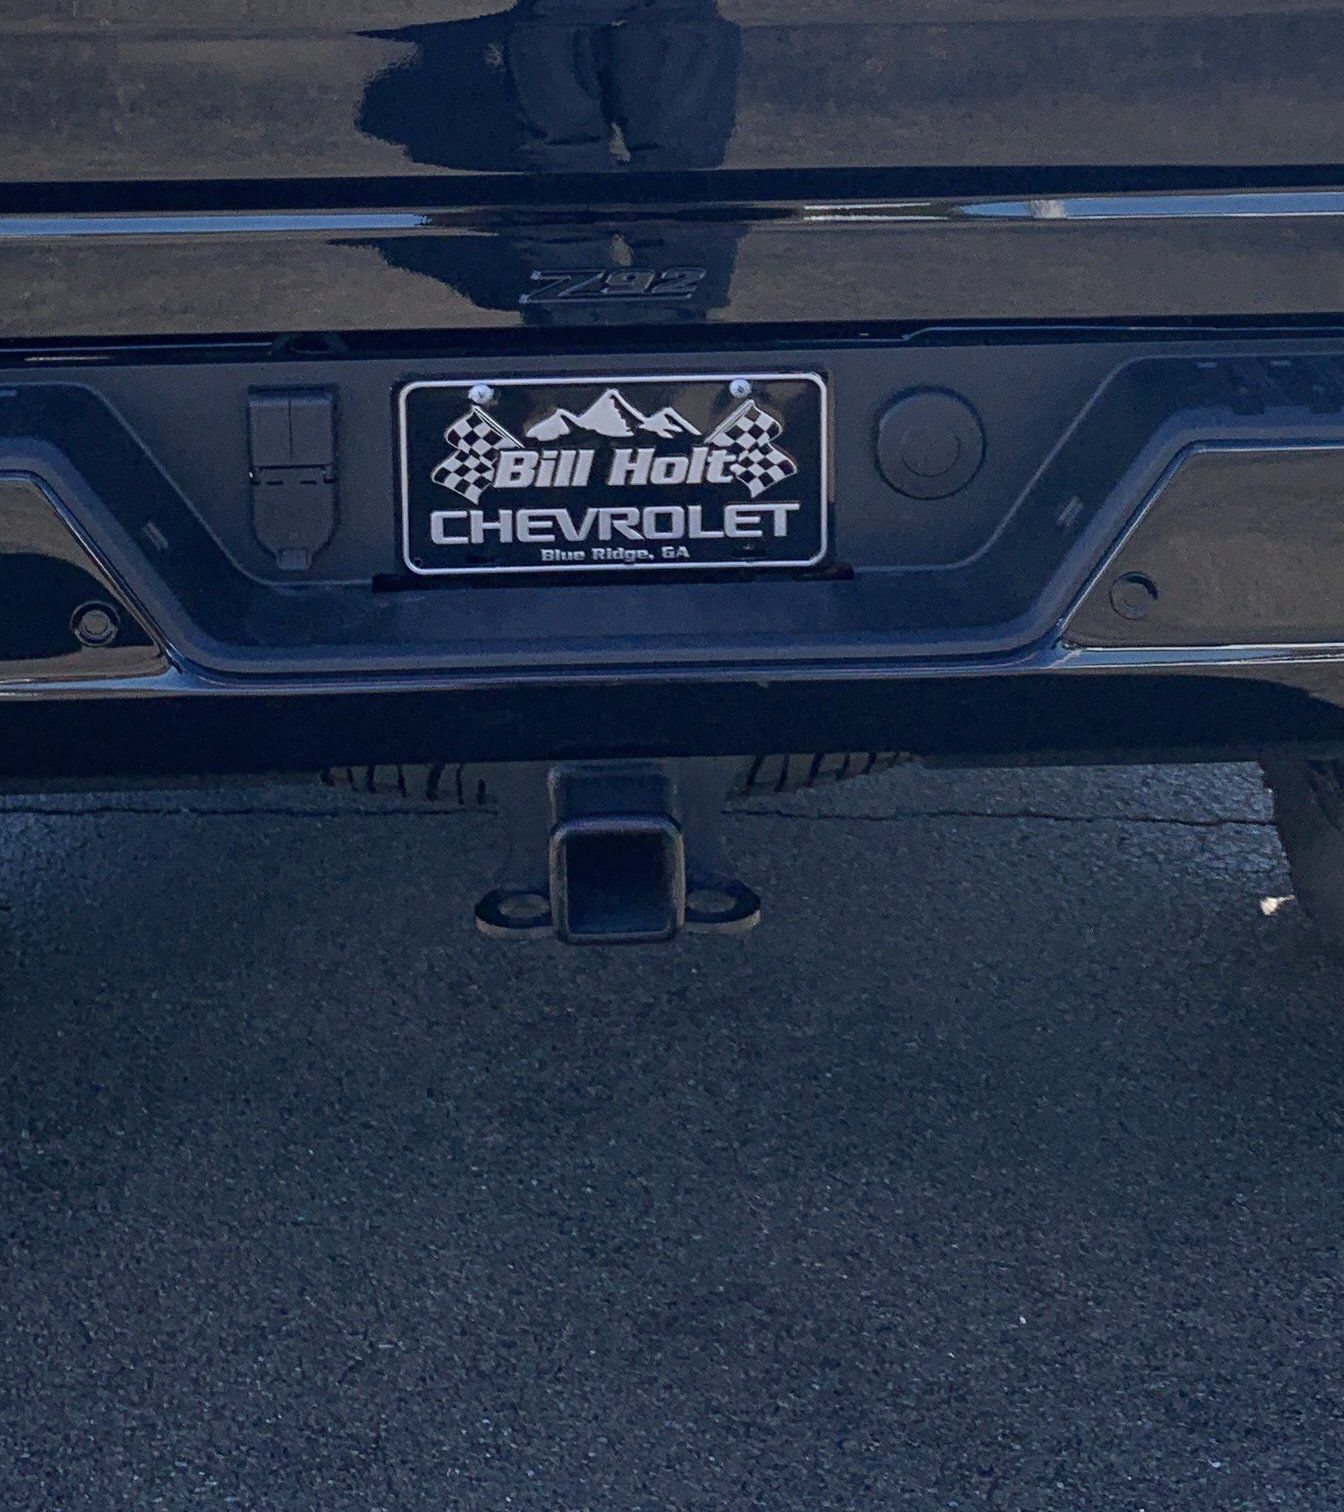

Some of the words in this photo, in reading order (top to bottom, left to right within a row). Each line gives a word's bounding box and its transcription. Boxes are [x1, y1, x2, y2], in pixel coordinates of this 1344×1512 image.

[493, 449, 595, 489] Bill
[606, 446, 738, 487] Holt
[429, 503, 801, 545] CHEVROLET
[541, 548, 586, 562] Blue
[591, 547, 656, 563] Ridge,
[661, 545, 691, 559] GA
